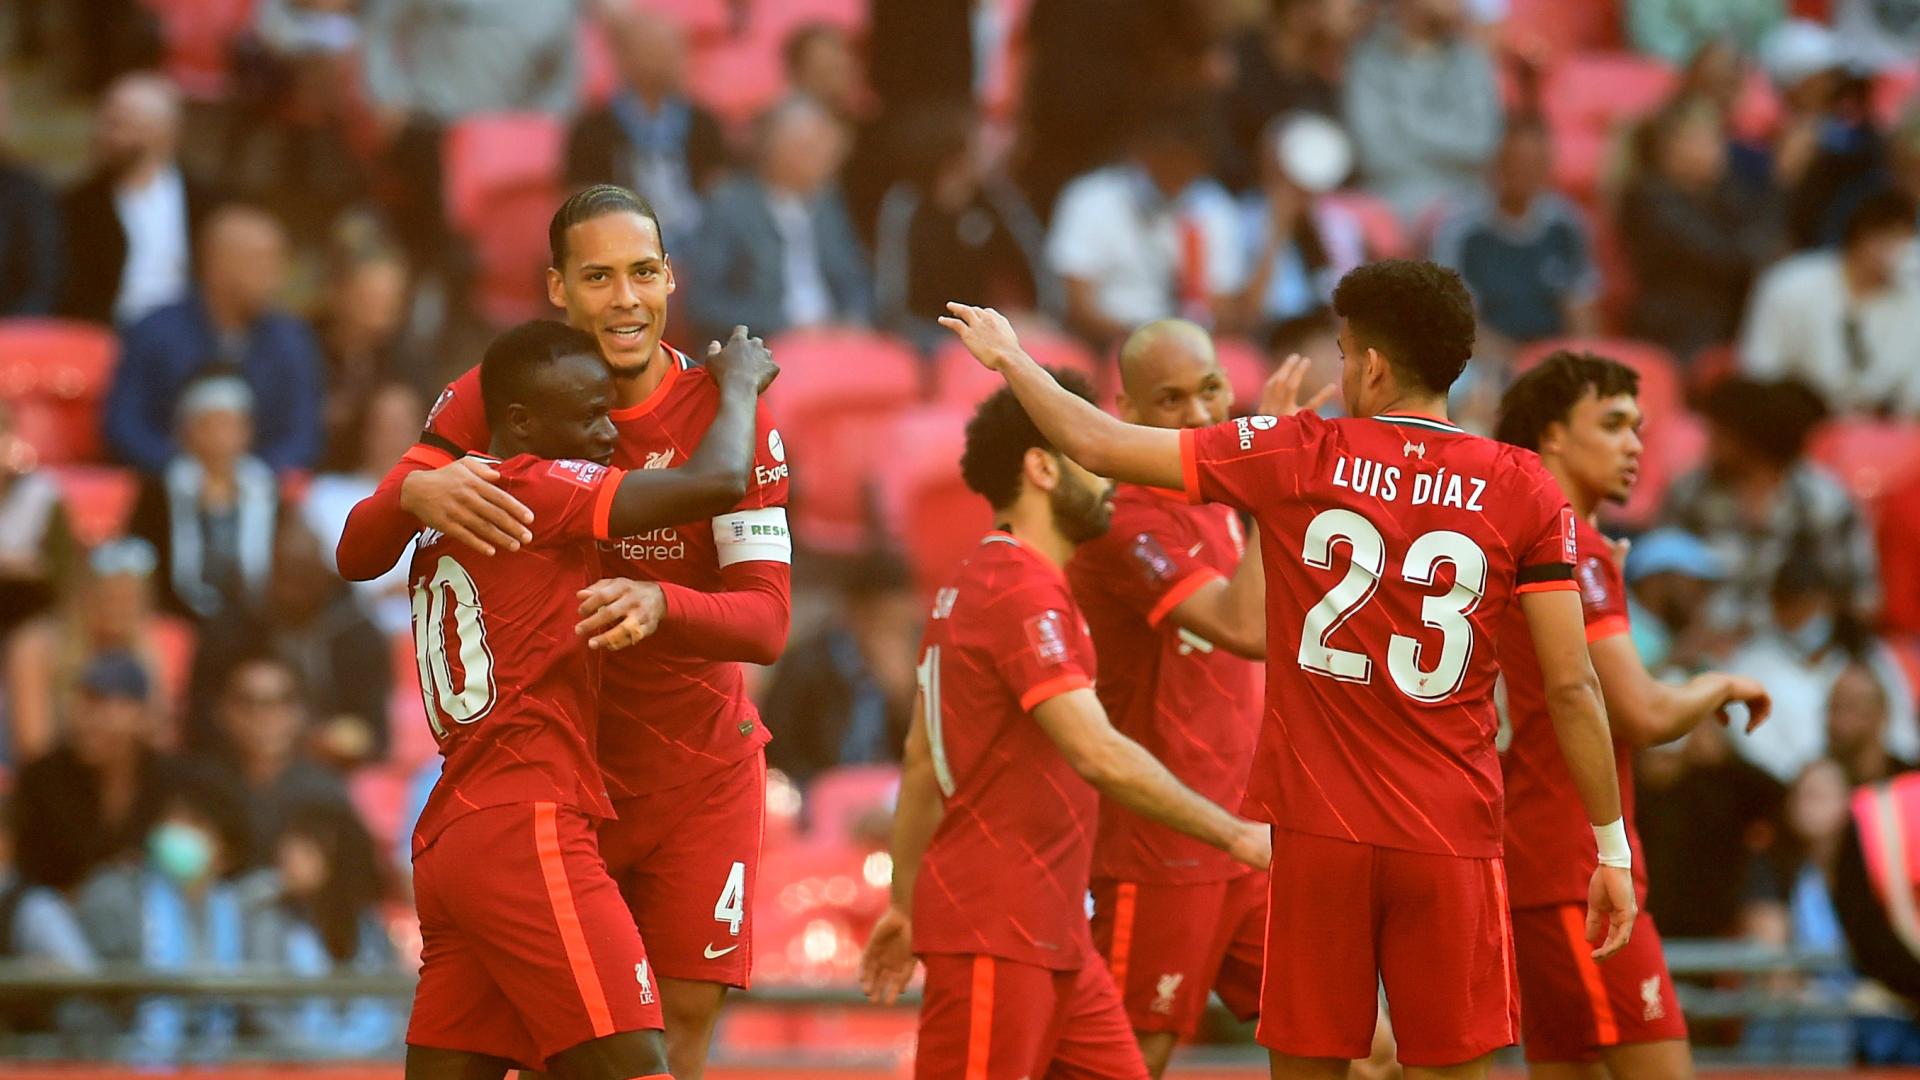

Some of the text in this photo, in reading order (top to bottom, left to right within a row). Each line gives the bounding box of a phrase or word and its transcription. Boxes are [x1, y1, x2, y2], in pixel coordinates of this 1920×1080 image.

[1332, 456, 1487, 512] LUIS DÍAZ
[750, 525, 790, 539] RESP
[1298, 508, 1489, 703] 23
[411, 554, 498, 740] 10
[714, 861, 746, 936] 4
